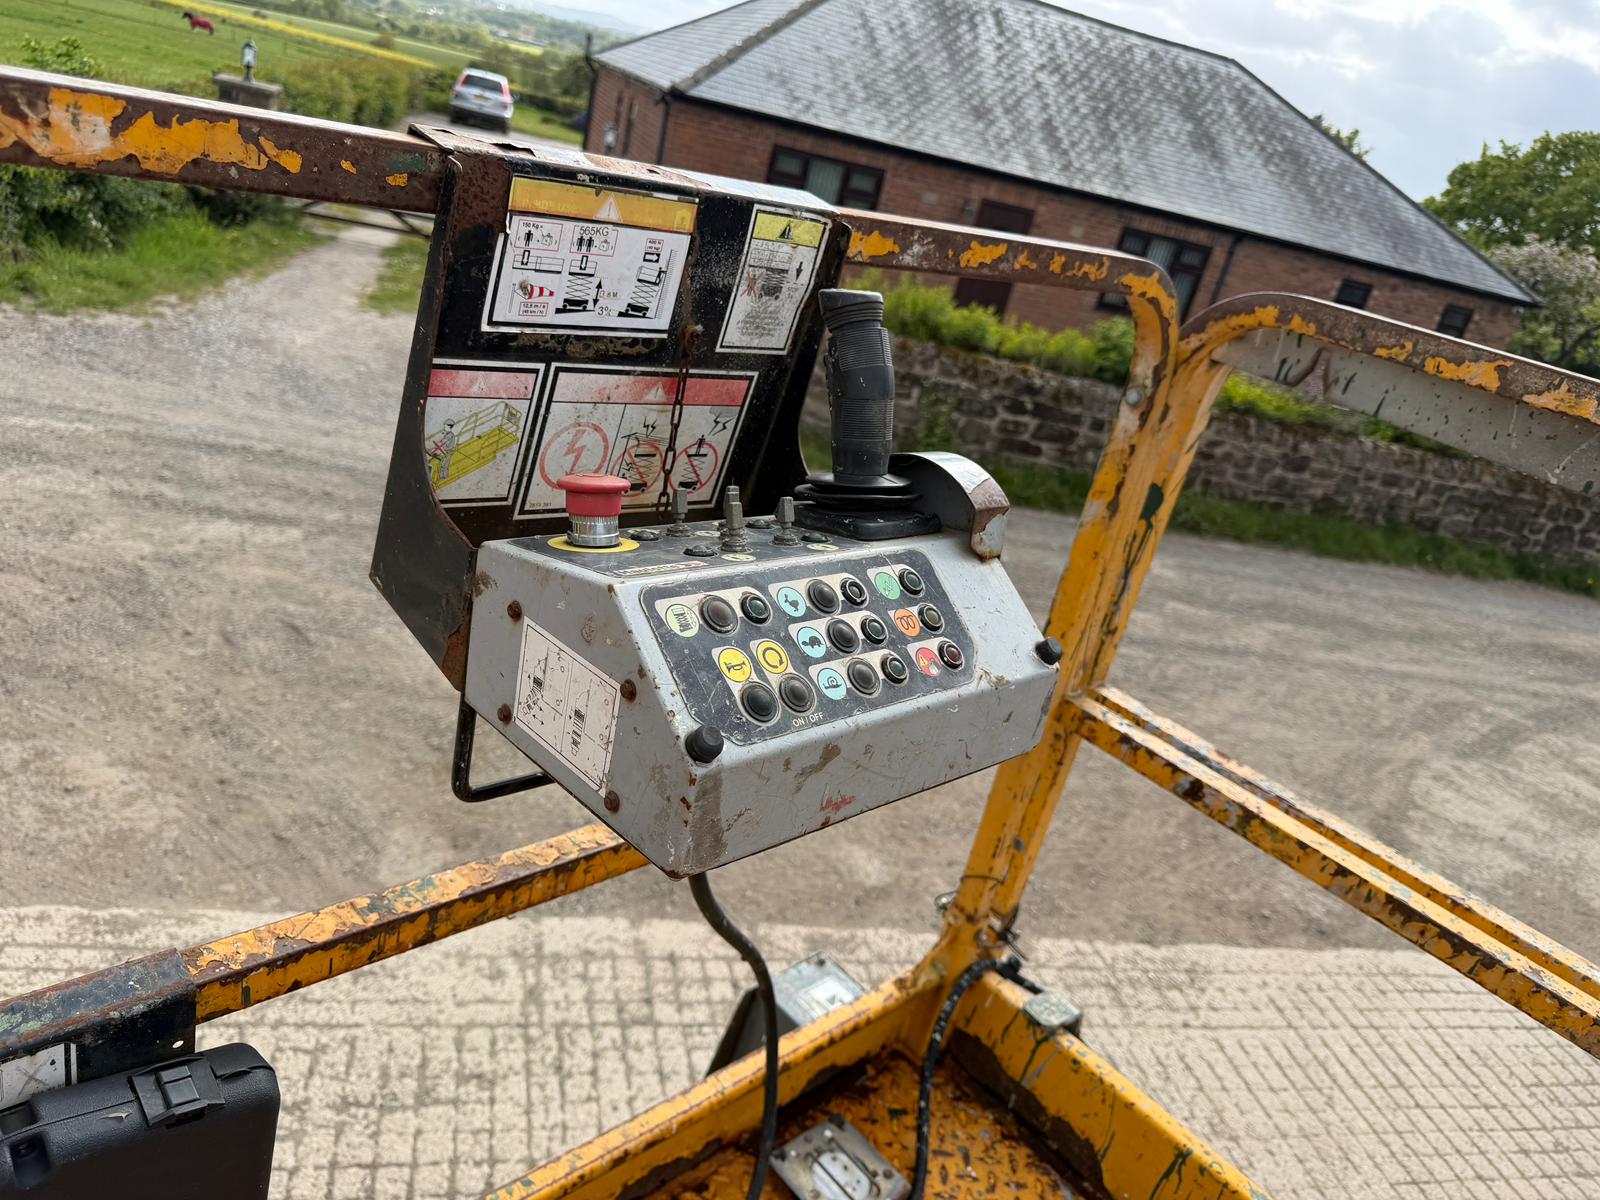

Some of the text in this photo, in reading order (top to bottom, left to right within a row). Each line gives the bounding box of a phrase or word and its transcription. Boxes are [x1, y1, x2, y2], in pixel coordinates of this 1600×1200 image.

[579, 225, 610, 237] 565KG
[792, 717, 805, 727] ON
[808, 711, 824, 723] OFF
